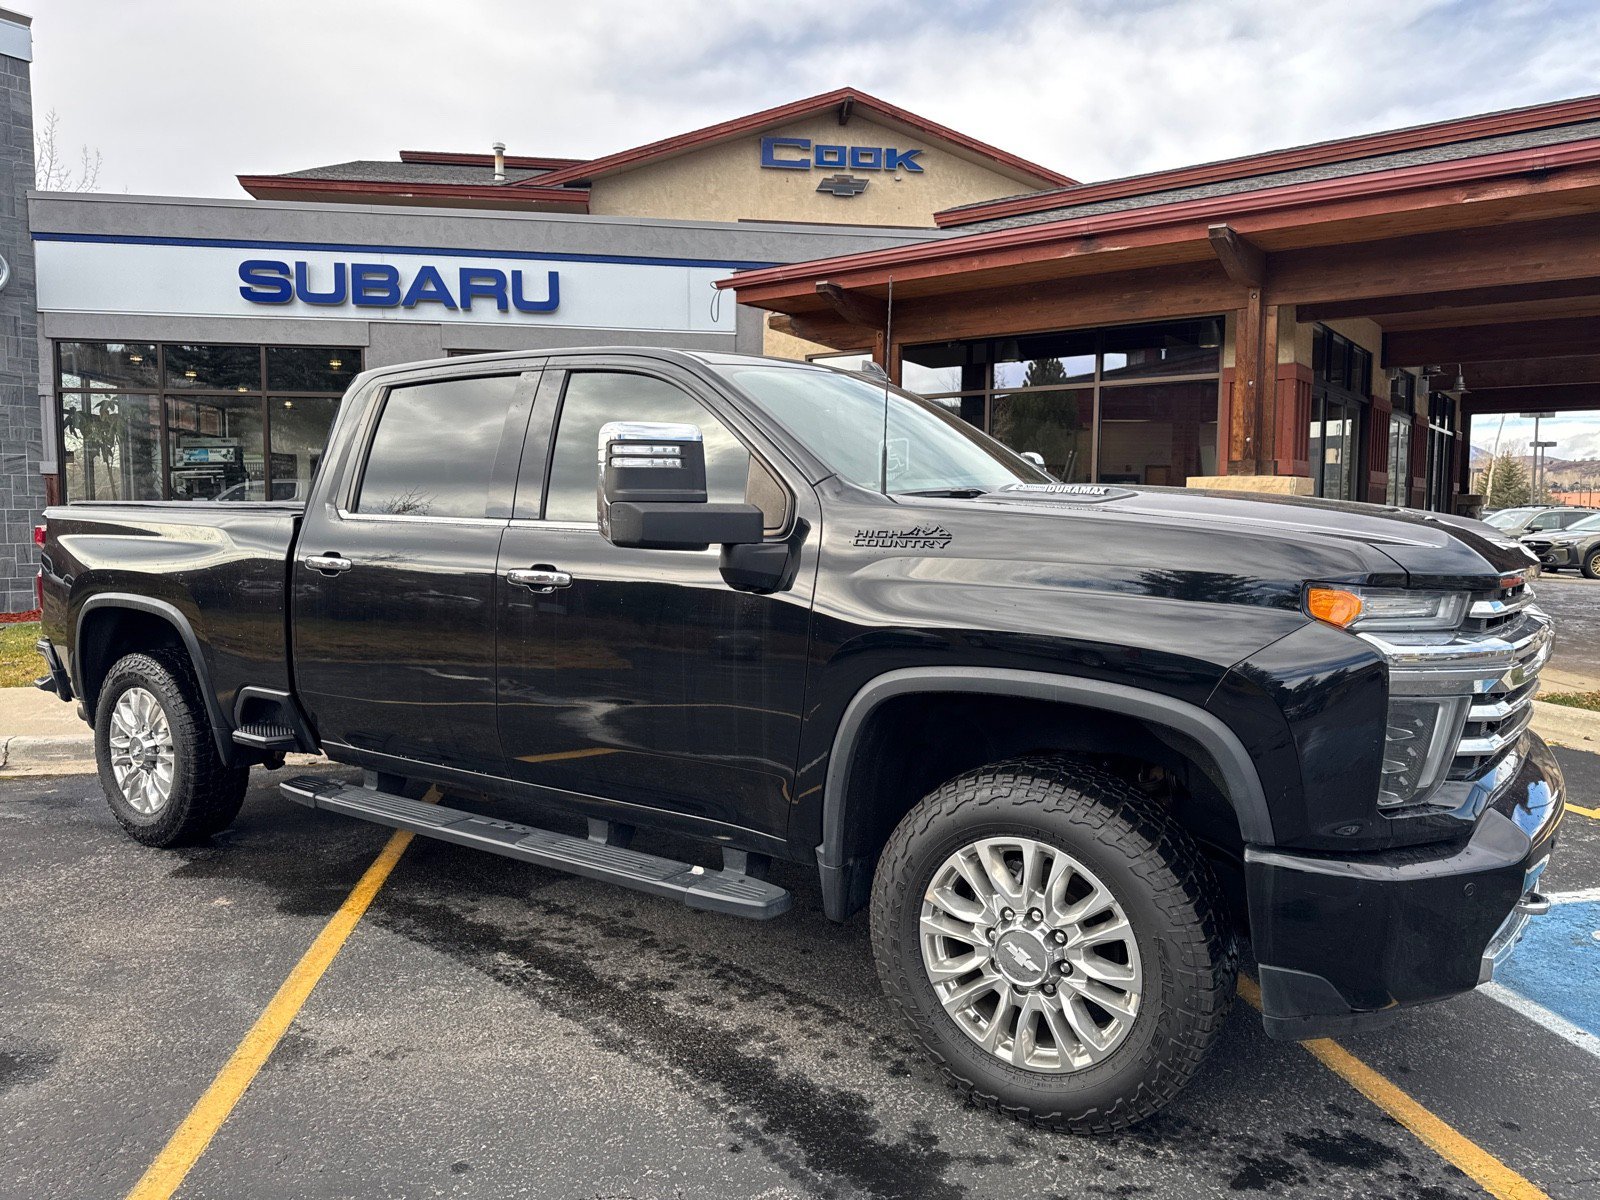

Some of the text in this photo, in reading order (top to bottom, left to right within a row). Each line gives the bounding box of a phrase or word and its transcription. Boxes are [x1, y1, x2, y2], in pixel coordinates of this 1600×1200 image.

[238, 259, 560, 313] SUBARU
[1046, 484, 1109, 495] DURAMAX
[854, 529, 903, 538] HIGH
[852, 538, 951, 549] COUNTRY
[1138, 935, 1174, 1070] FALKEN
